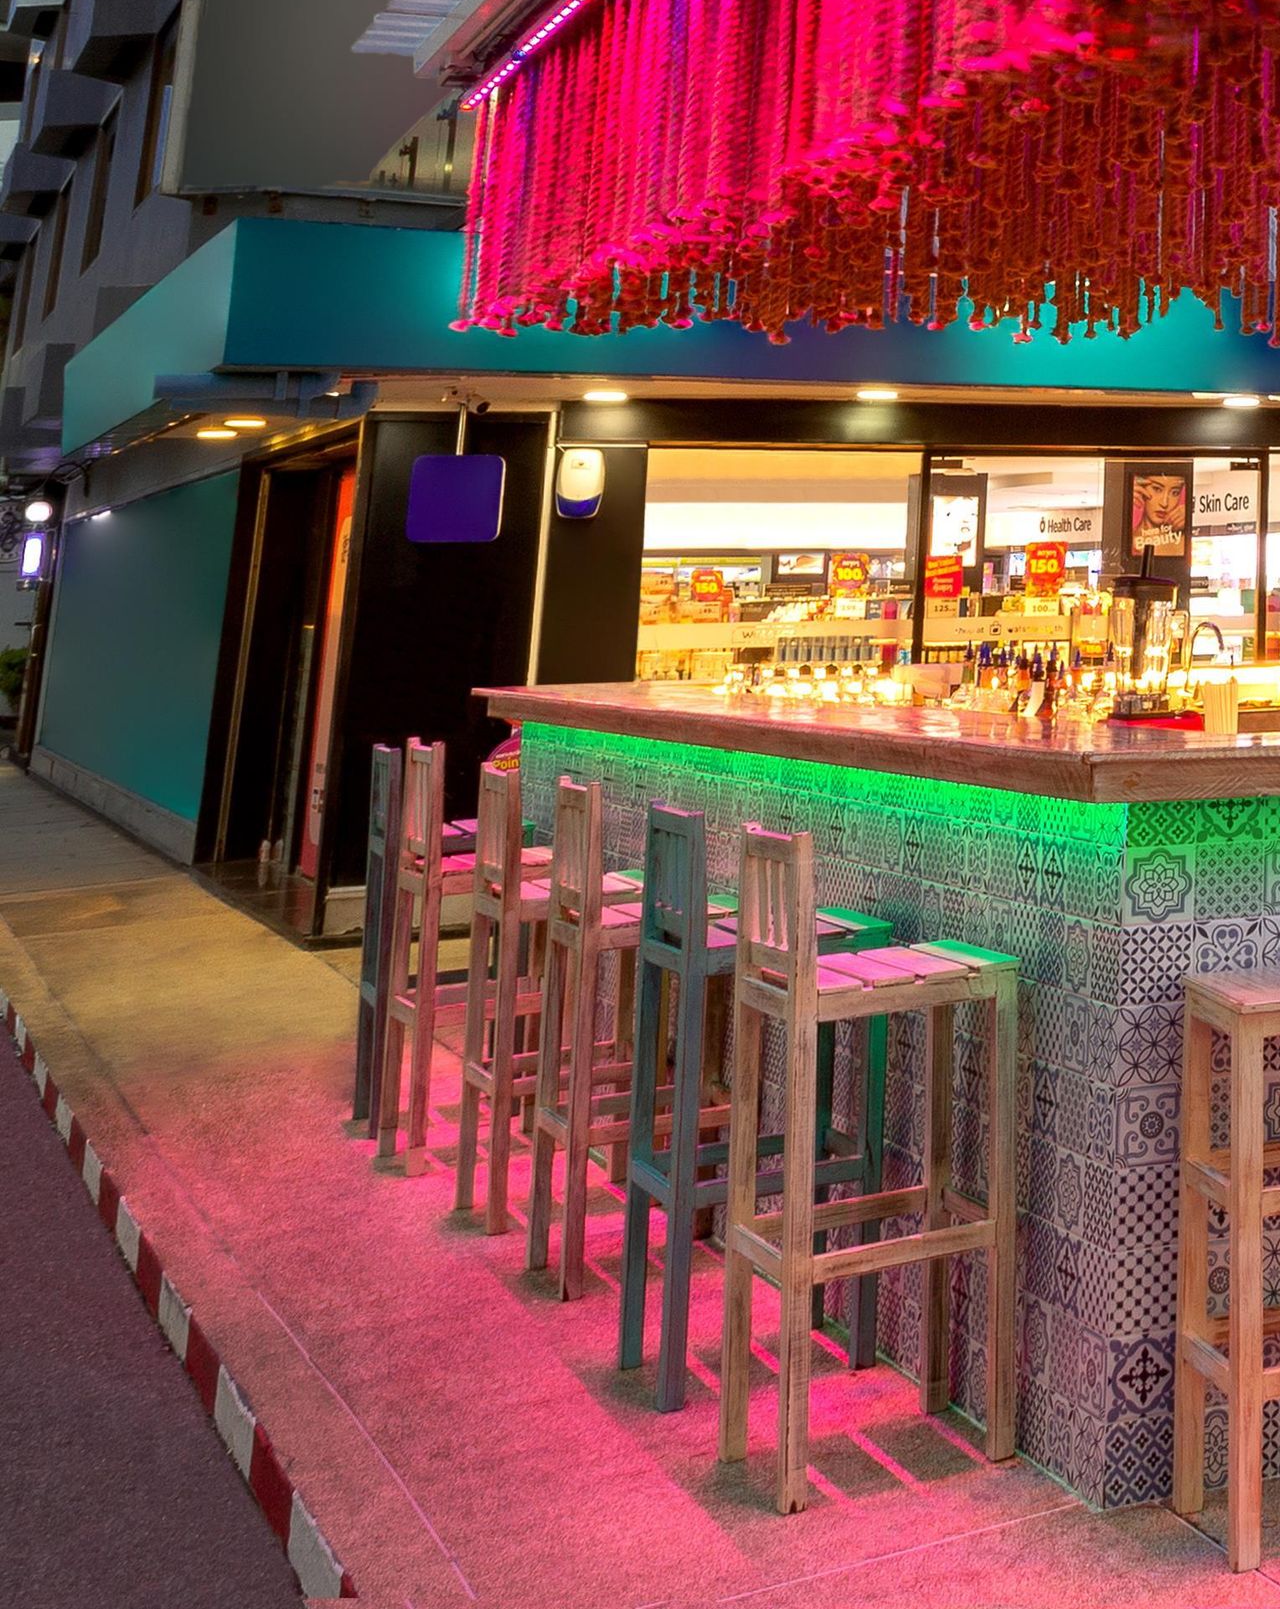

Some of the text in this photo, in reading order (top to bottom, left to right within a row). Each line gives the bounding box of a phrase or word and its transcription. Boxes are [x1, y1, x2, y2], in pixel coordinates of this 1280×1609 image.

[1199, 493, 1249, 513] Skin Care
[1047, 517, 1092, 534] Health Care
[1160, 524, 1173, 533] for
[1135, 530, 1182, 550] Beauty
[837, 567, 862, 581] 100
[1030, 559, 1058, 574] 150
[695, 582, 718, 594] 150
